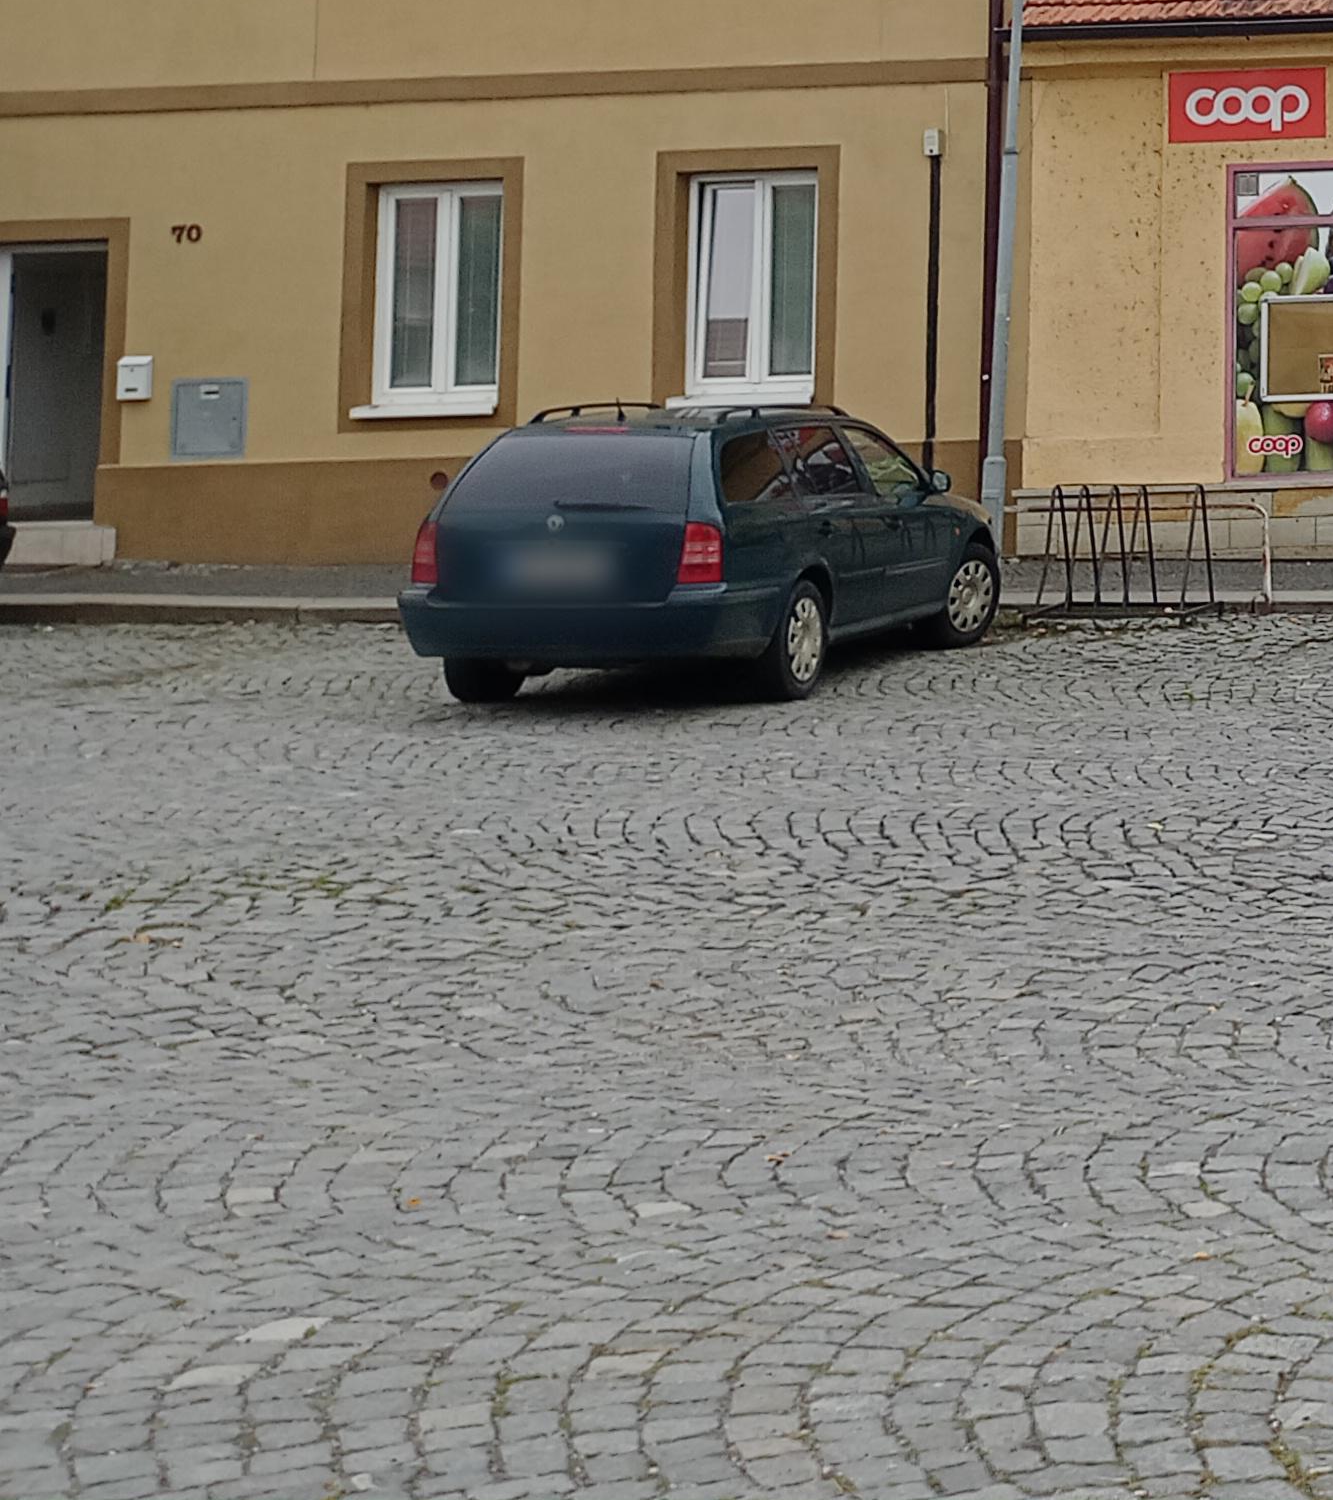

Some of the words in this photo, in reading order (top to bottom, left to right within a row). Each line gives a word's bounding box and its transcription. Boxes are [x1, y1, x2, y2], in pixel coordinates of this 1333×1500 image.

[1185, 84, 1310, 132] coop
[171, 224, 202, 244] 70
[1248, 437, 1301, 456] coop
